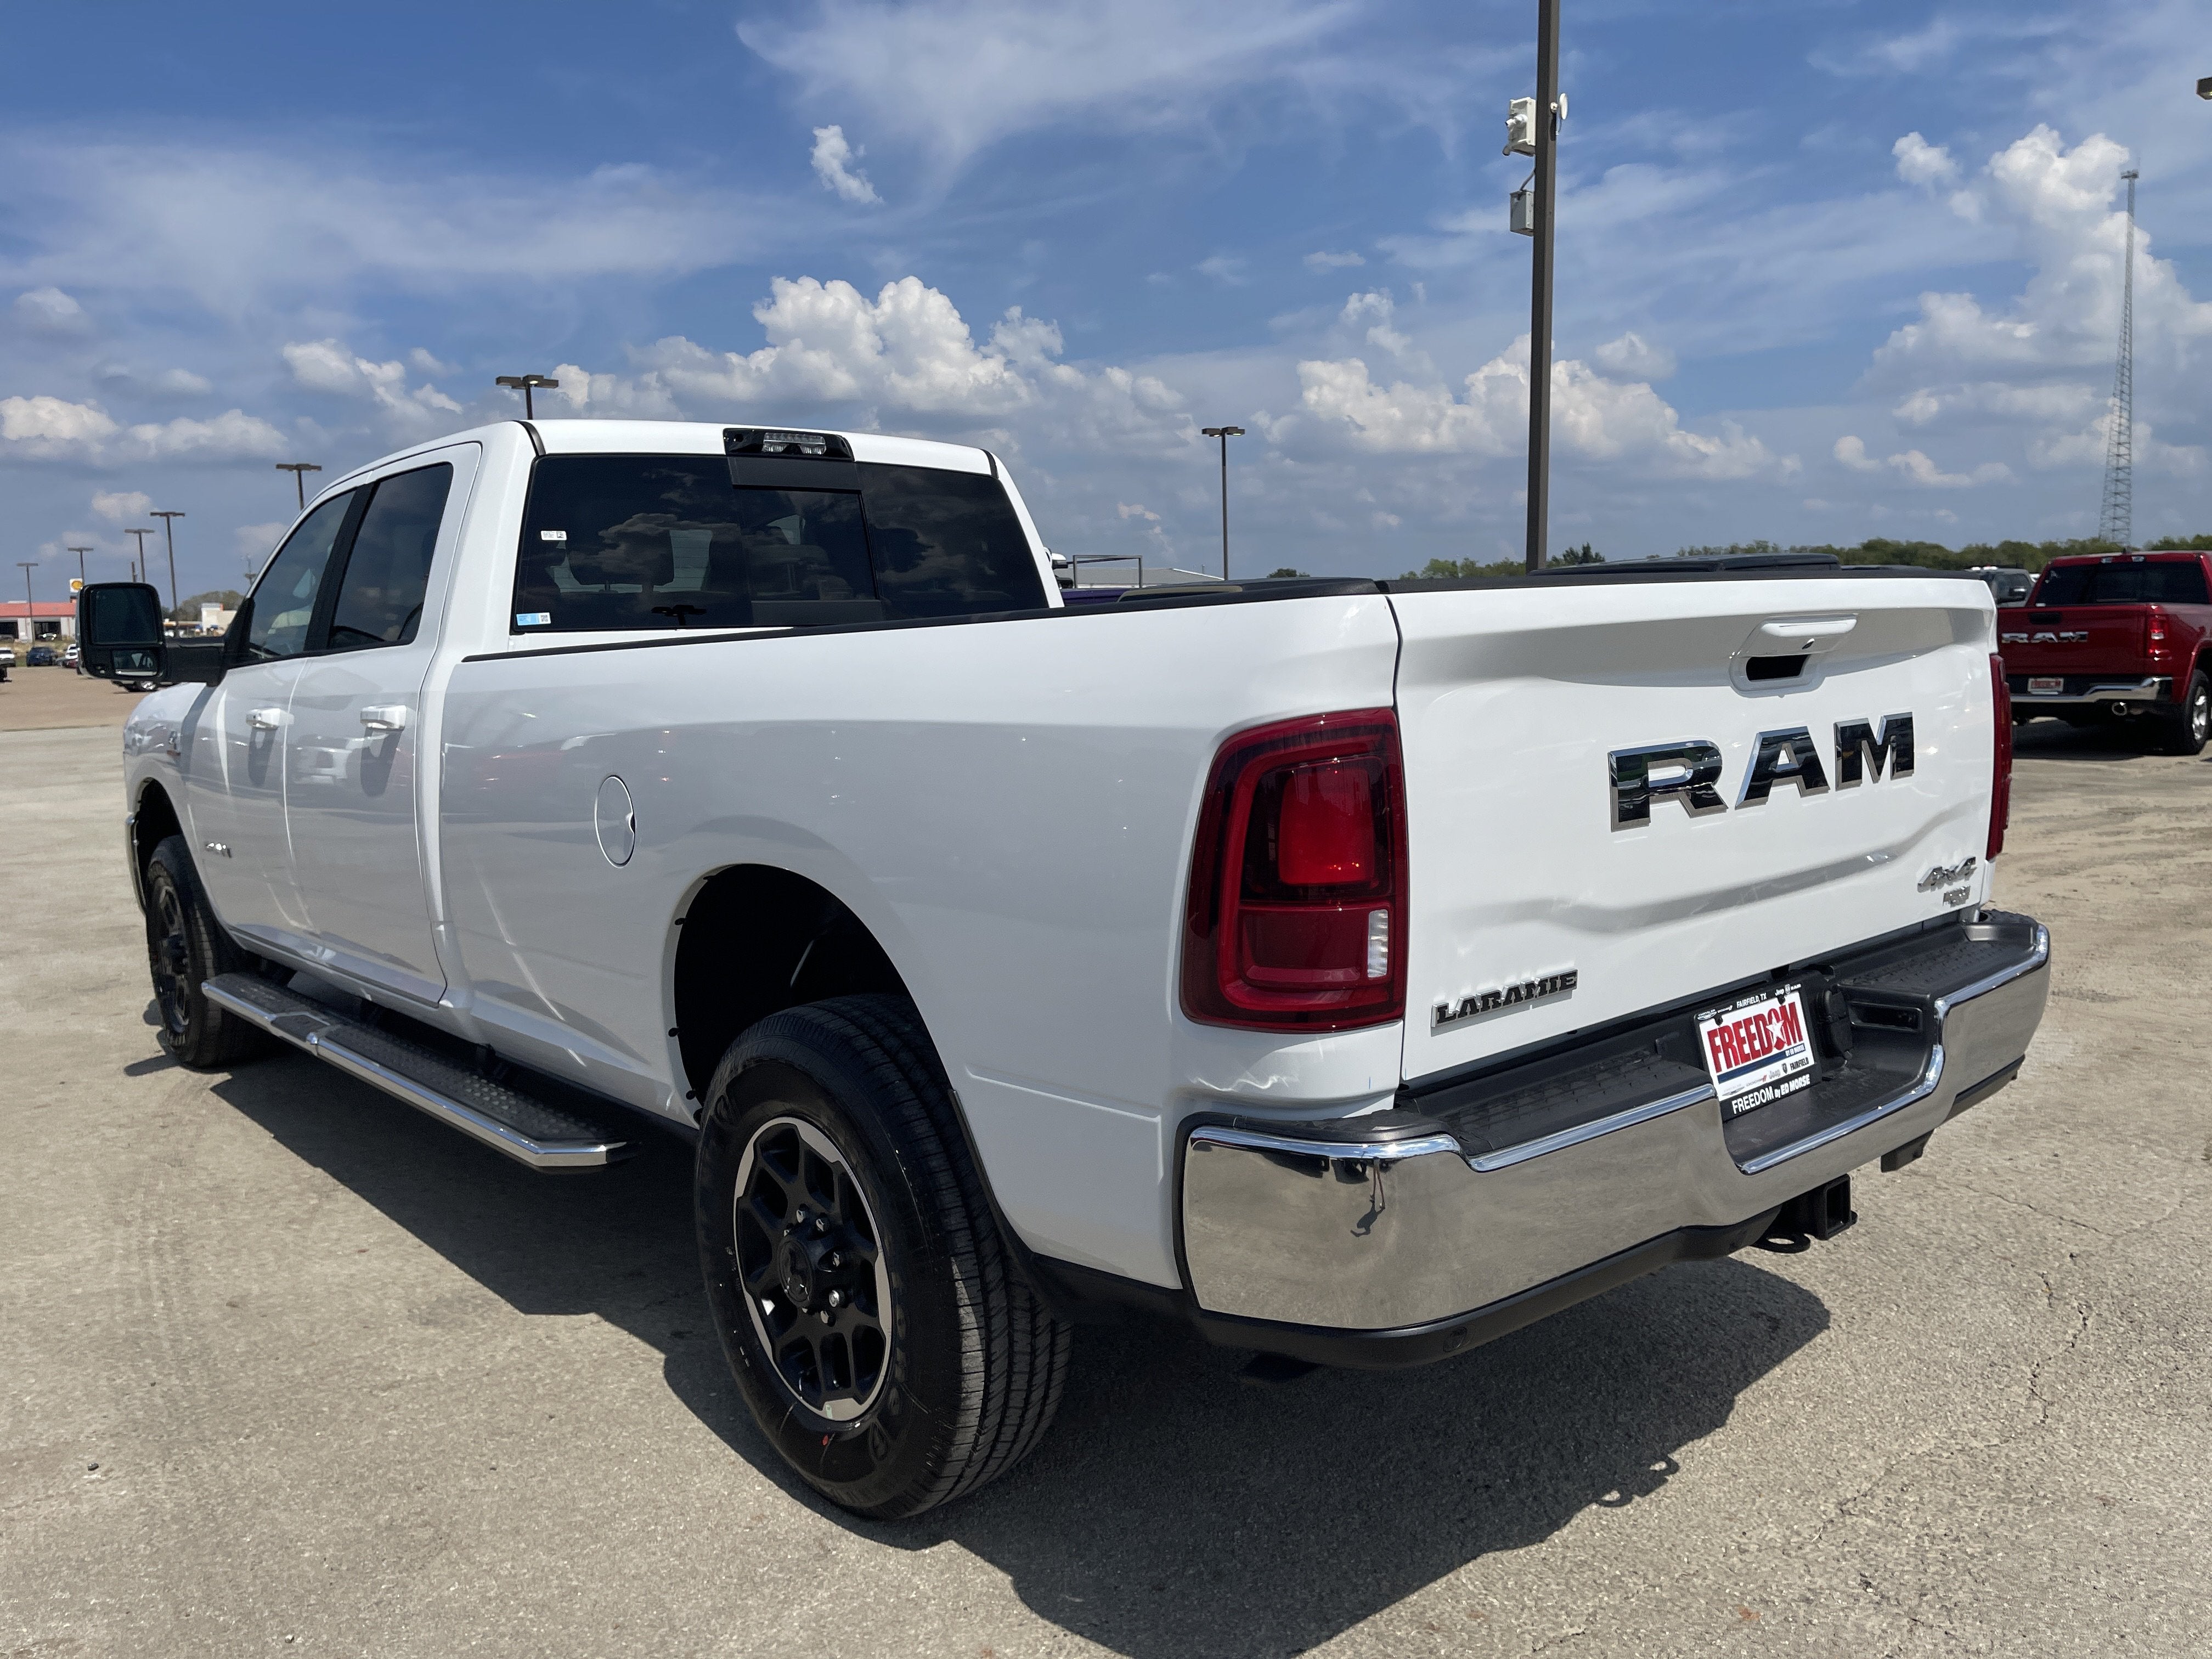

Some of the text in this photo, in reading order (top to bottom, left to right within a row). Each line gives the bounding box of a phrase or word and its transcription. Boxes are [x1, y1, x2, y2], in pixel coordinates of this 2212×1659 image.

[2001, 631, 2089, 643] RAM
[1608, 712, 1914, 832] RAM
[1431, 968, 1578, 1028] LARAMIE
[1736, 992, 1767, 1008] FAIRFIELD, TX
[1707, 1001, 1803, 1073] FREEDOM
[1790, 1057, 1809, 1071] FAIRFIELD
[1731, 1086, 1774, 1114] FREEDOM
[1780, 1082, 1790, 1096] ED
[1789, 1074, 1810, 1092] MORSE
